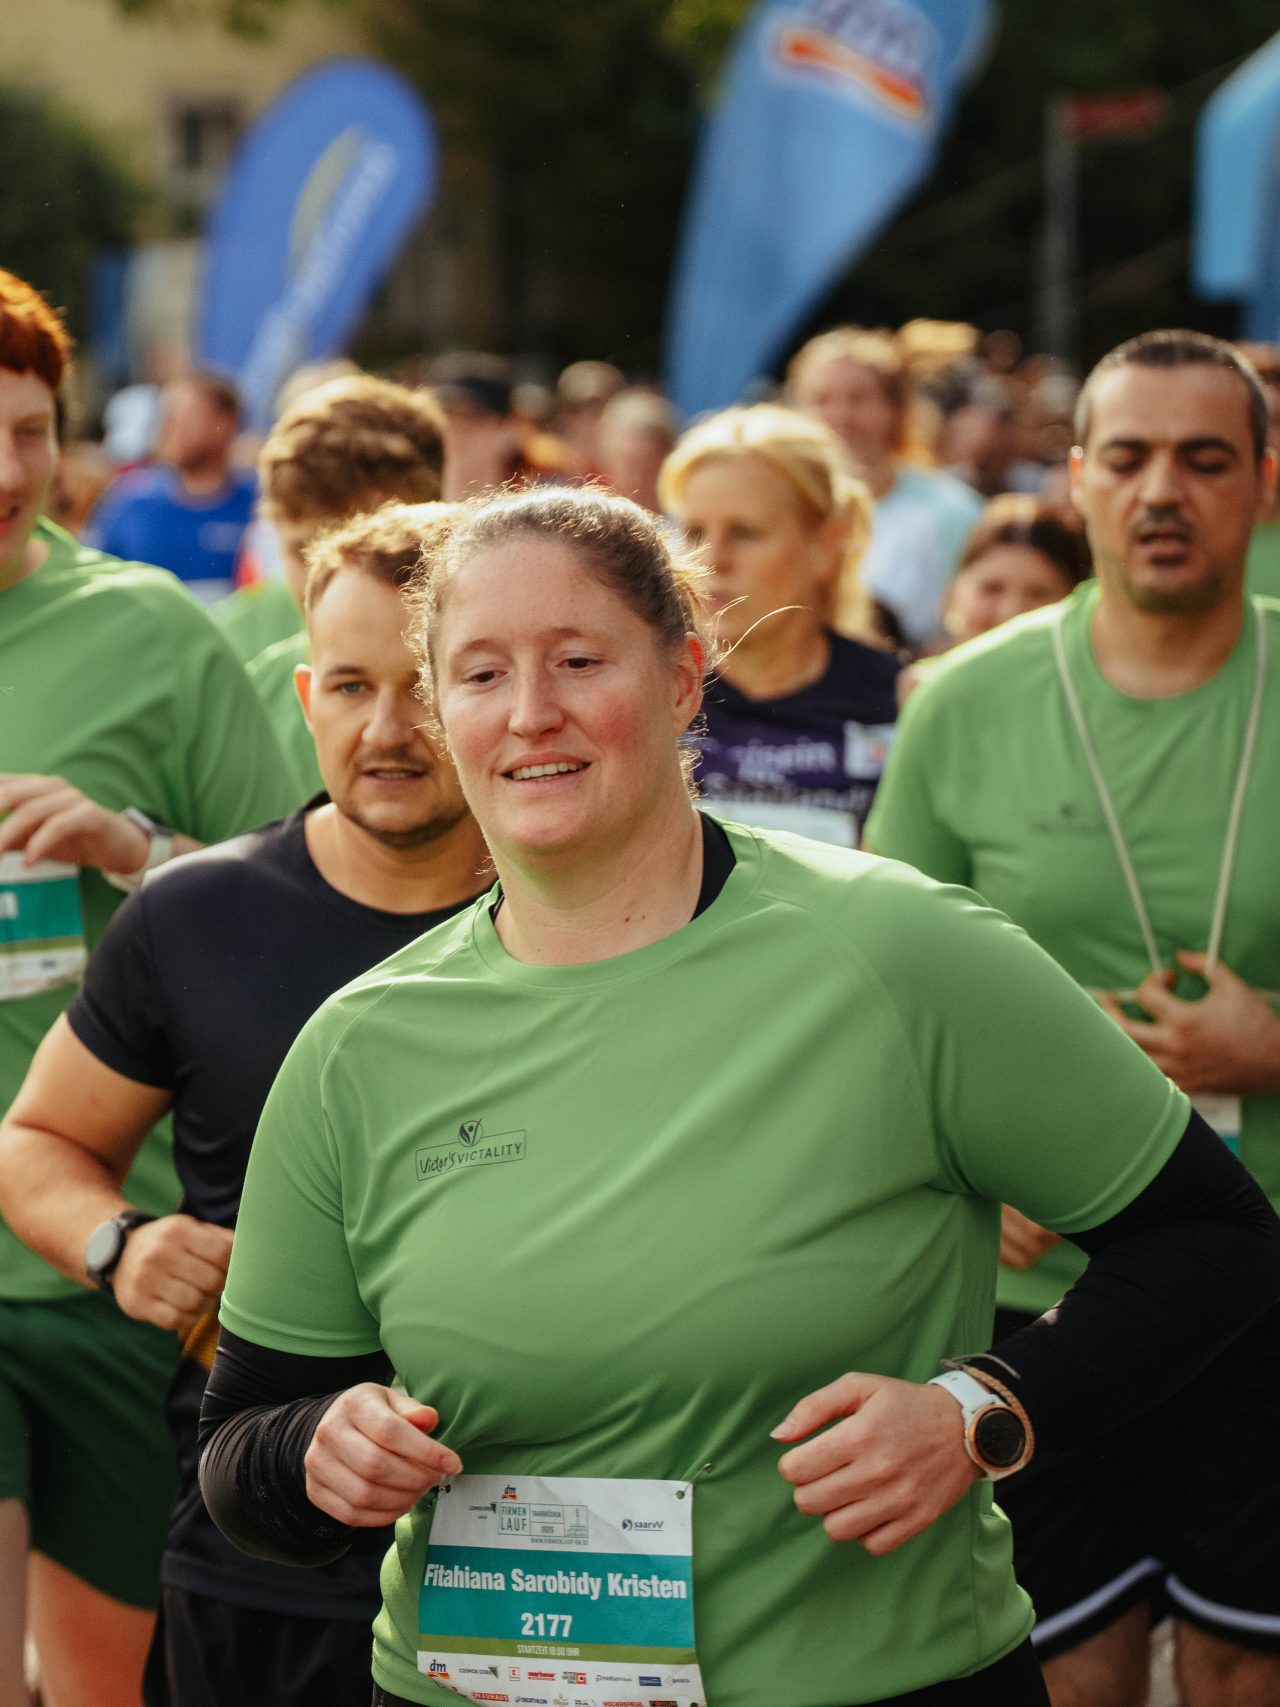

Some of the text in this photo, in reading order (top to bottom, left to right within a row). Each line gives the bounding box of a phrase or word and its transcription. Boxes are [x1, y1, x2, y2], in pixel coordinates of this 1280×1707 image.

[420, 1142, 522, 1174] Victor's VICTALITY
[502, 1505, 527, 1516] FIRMEN
[500, 1518, 527, 1532] LAUF
[423, 1563, 687, 1601] Fitahiana Sarobidy Kristen
[521, 1612, 573, 1638] 2177
[517, 1644, 548, 1655] STARTZEIT
[430, 1660, 446, 1673] dm
